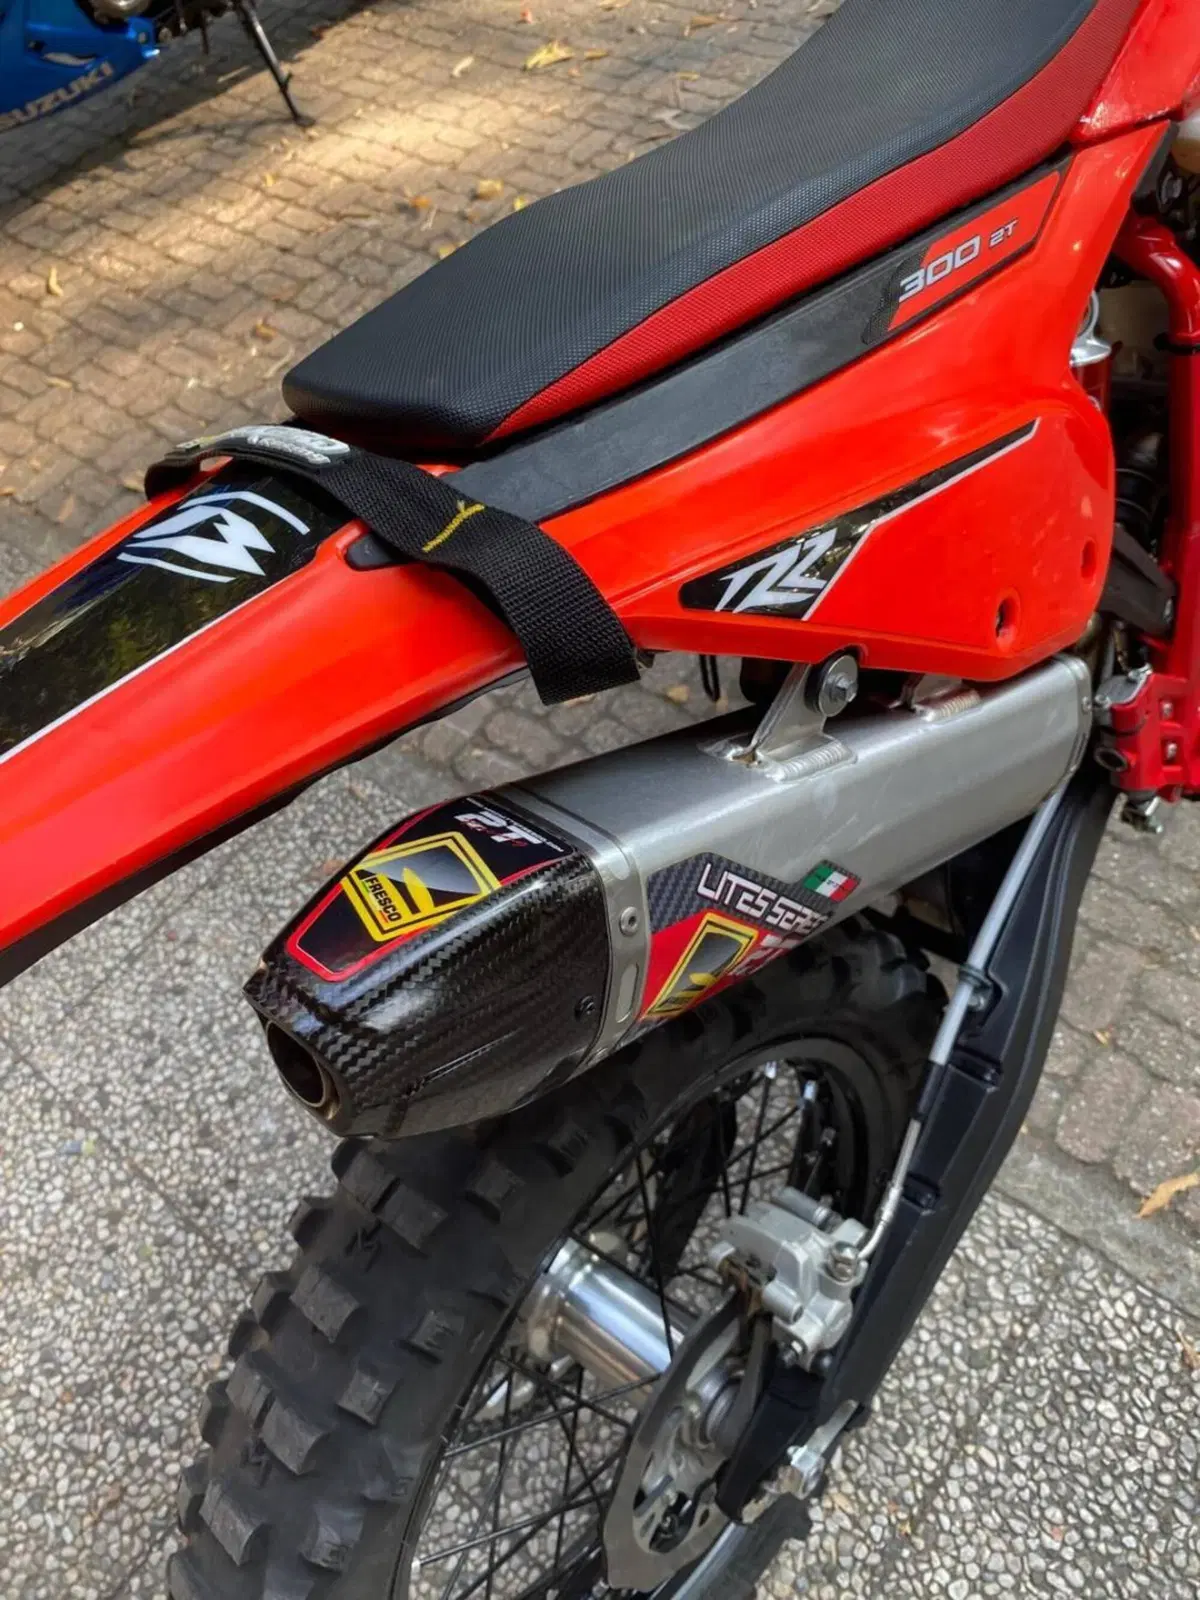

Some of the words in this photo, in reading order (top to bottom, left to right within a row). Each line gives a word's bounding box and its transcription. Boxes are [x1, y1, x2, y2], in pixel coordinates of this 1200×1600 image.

[898, 235, 981, 303] 300
[988, 219, 1018, 248] 2T
[364, 875, 402, 922] FRESCO
